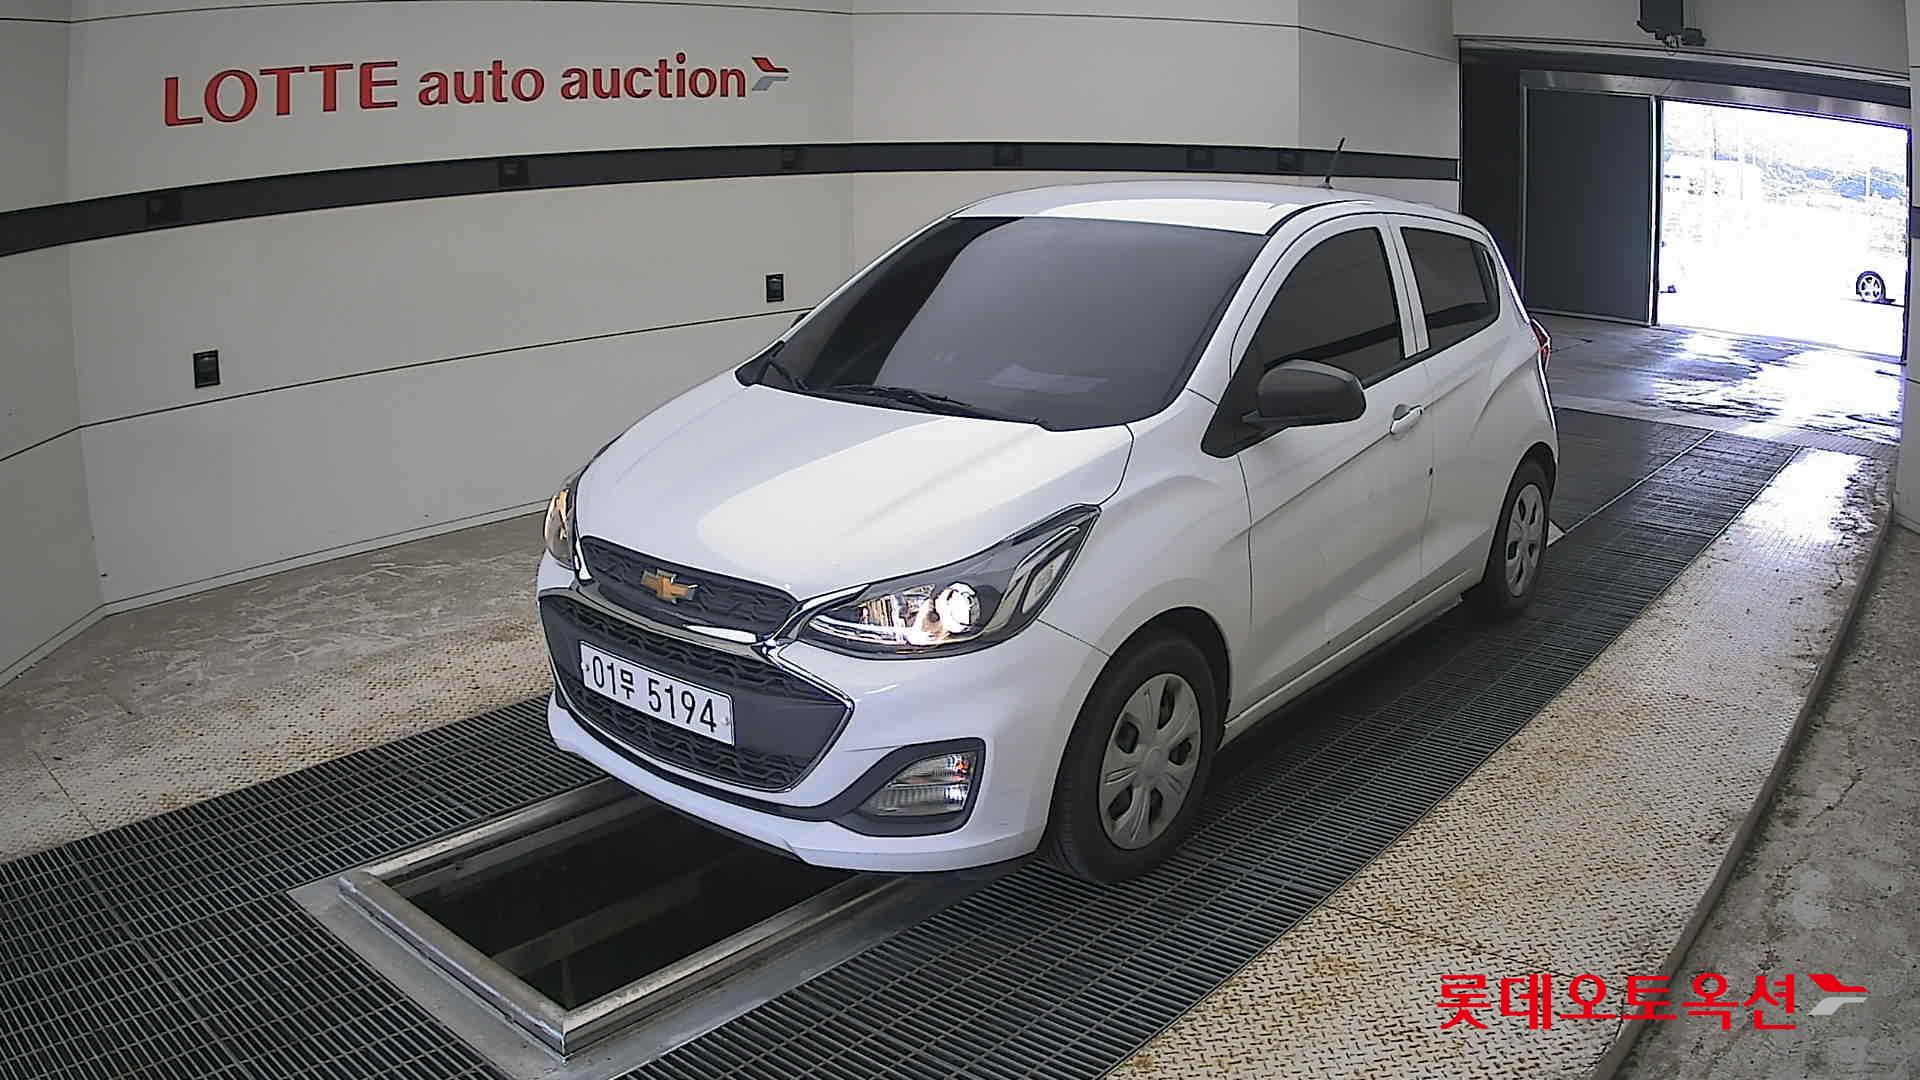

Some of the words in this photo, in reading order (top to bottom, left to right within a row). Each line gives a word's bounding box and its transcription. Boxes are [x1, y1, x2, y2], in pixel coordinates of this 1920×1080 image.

[163, 60, 399, 126] LOTTE
[417, 60, 546, 107] auto
[560, 52, 747, 100] auction
[592, 655, 635, 700] 01무
[648, 677, 717, 733] 5194
